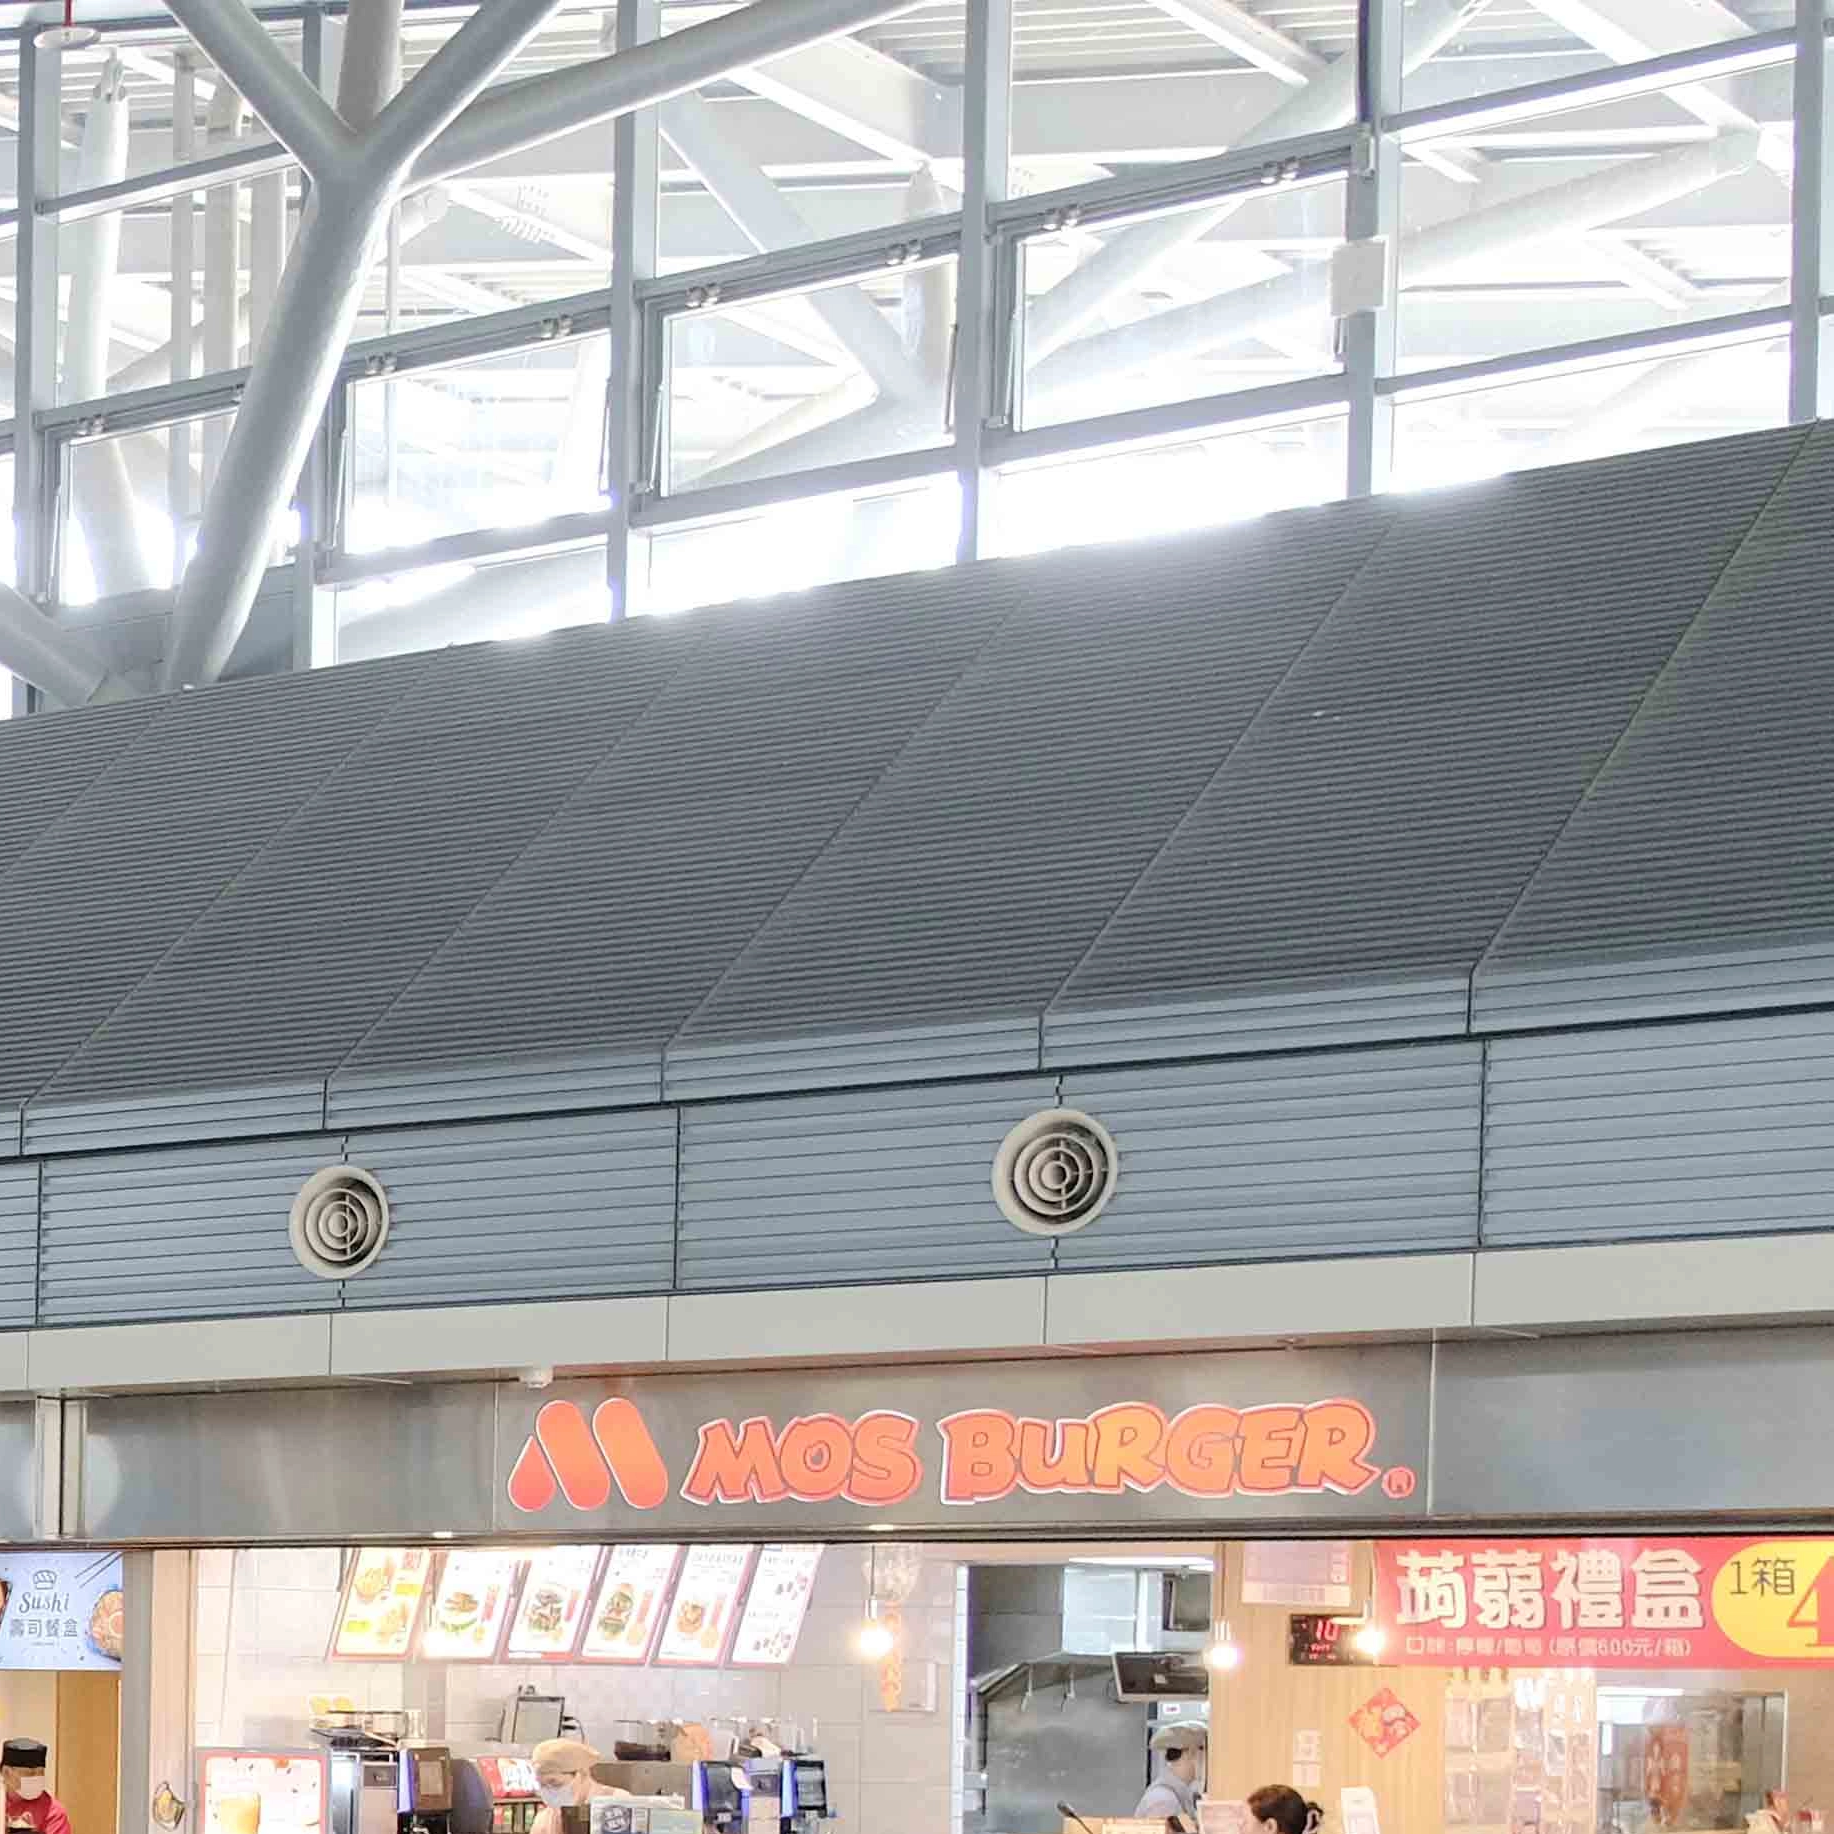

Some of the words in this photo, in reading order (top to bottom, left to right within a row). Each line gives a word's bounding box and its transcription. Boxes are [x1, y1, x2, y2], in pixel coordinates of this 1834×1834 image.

[680, 1408, 925, 1507] MOS
[19, 1592, 70, 1613] Sushi
[1395, 1548, 1705, 1630] 蒟蒻禮盒
